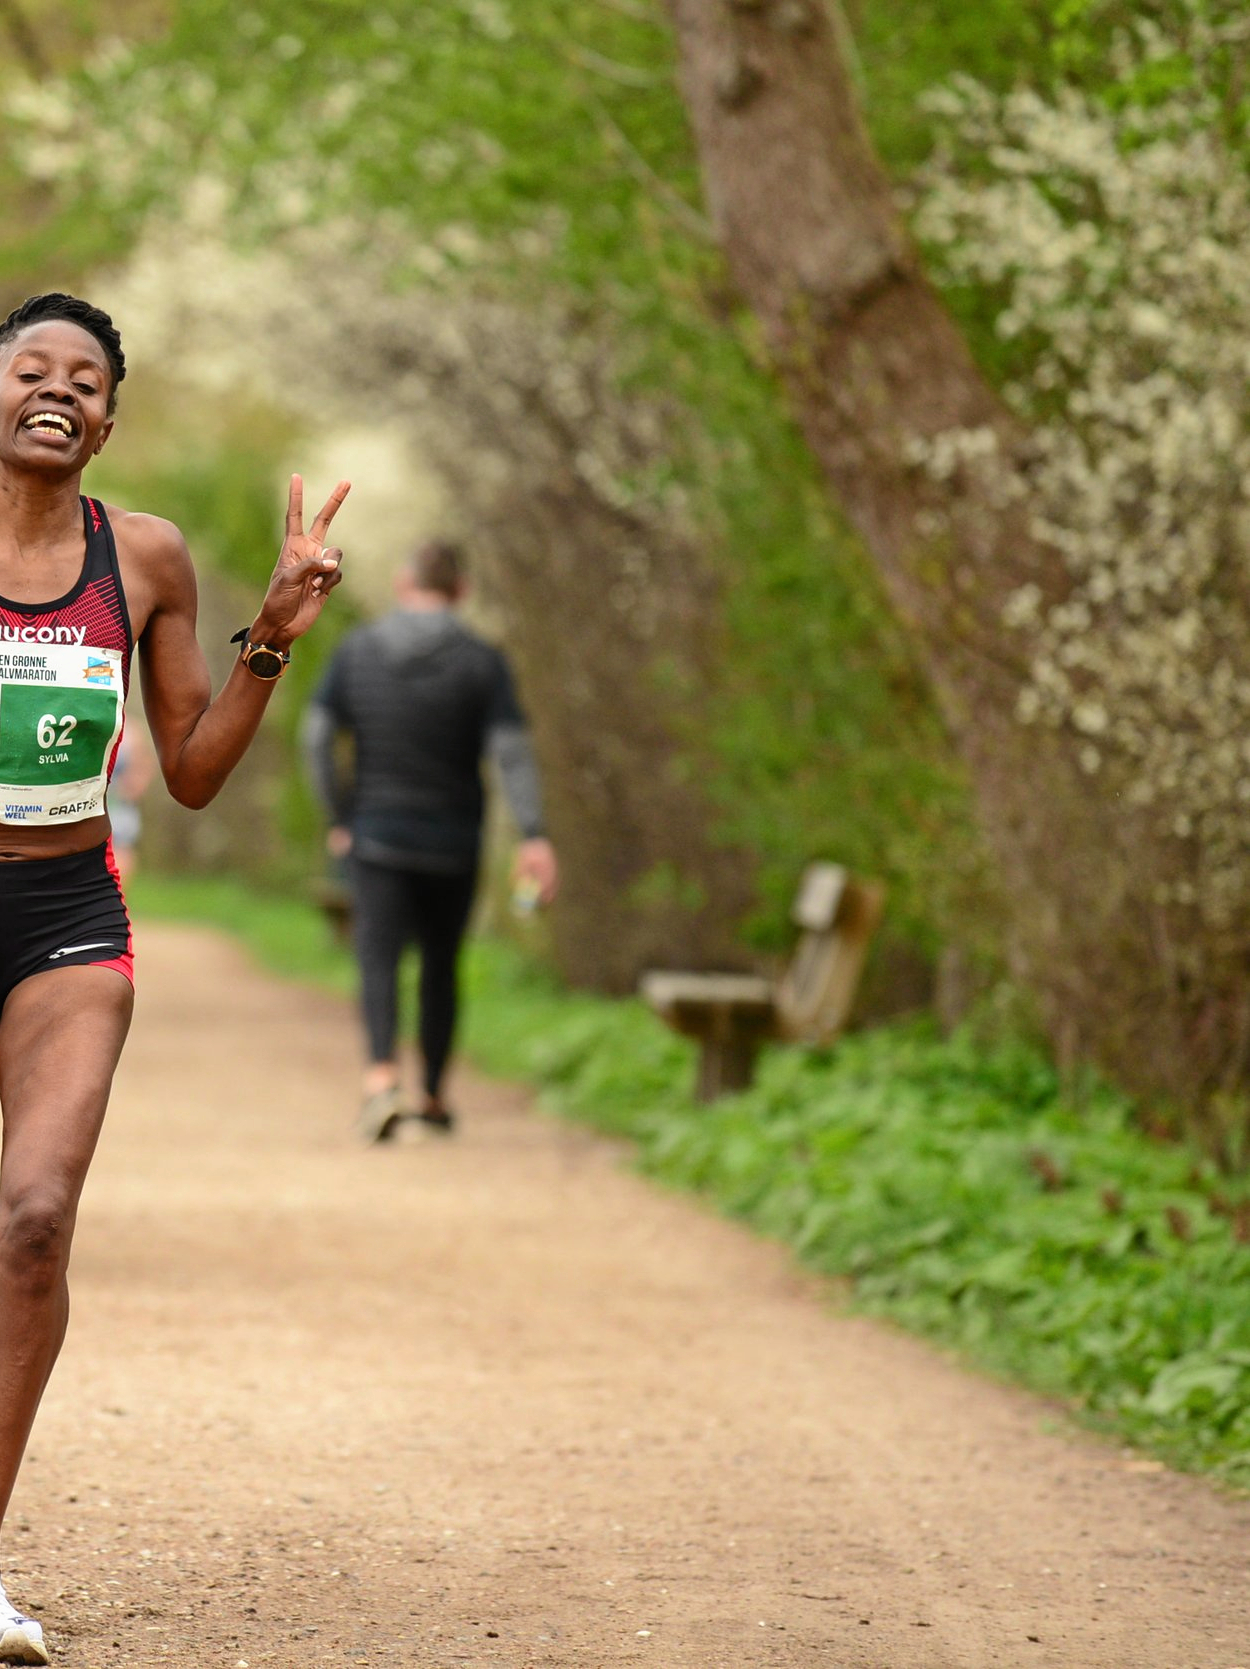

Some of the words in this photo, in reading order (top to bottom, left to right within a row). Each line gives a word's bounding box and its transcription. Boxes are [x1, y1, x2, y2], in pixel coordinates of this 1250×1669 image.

[12, 655, 48, 668] GRØNNE
[36, 713, 78, 749] 62
[38, 752, 69, 764] SYLVIA
[5, 804, 43, 813] VITAMIN
[48, 801, 90, 816] CRAFT
[5, 812, 27, 820] WELL
